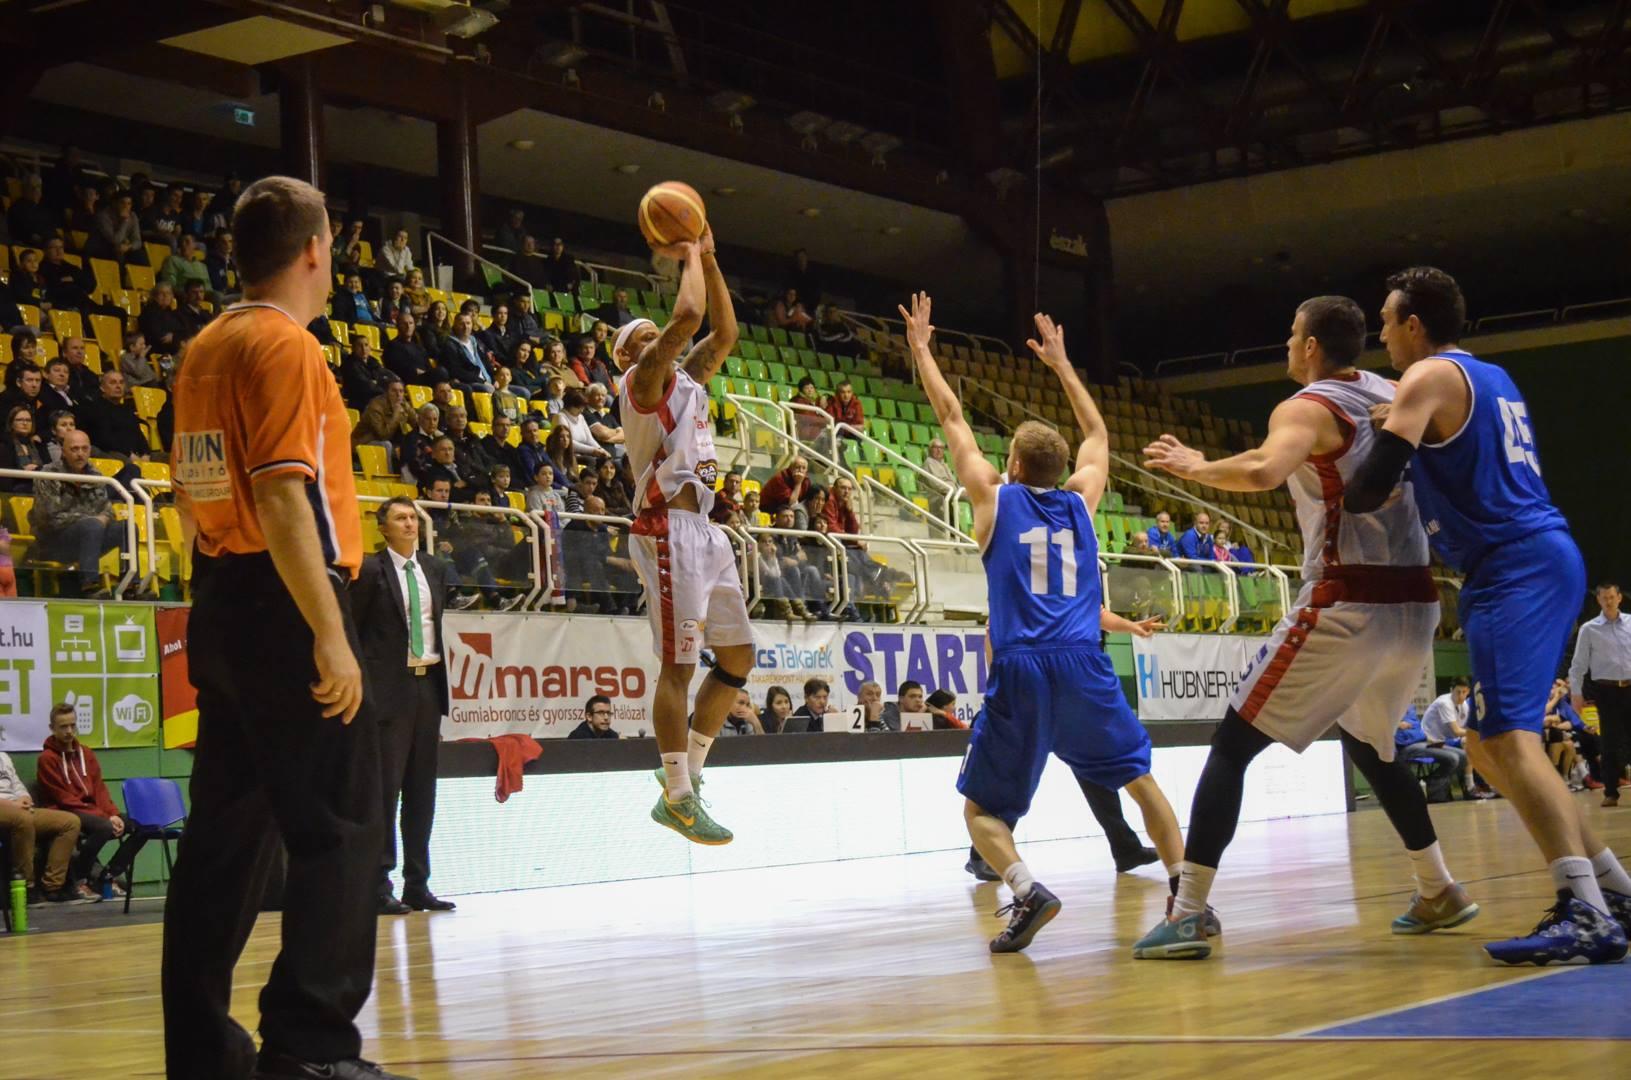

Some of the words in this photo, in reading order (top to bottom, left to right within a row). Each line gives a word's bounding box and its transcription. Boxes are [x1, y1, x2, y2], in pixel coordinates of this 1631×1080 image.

[1497, 397, 1541, 477] 45
[1019, 526, 1077, 597] 11
[495, 665, 646, 699] marso
[843, 631, 987, 696] START
[451, 705, 526, 723] Gumiabroncs
[528, 705, 540, 722] és
[543, 708, 585, 726] gyorssz
[852, 707, 862, 730] 2
